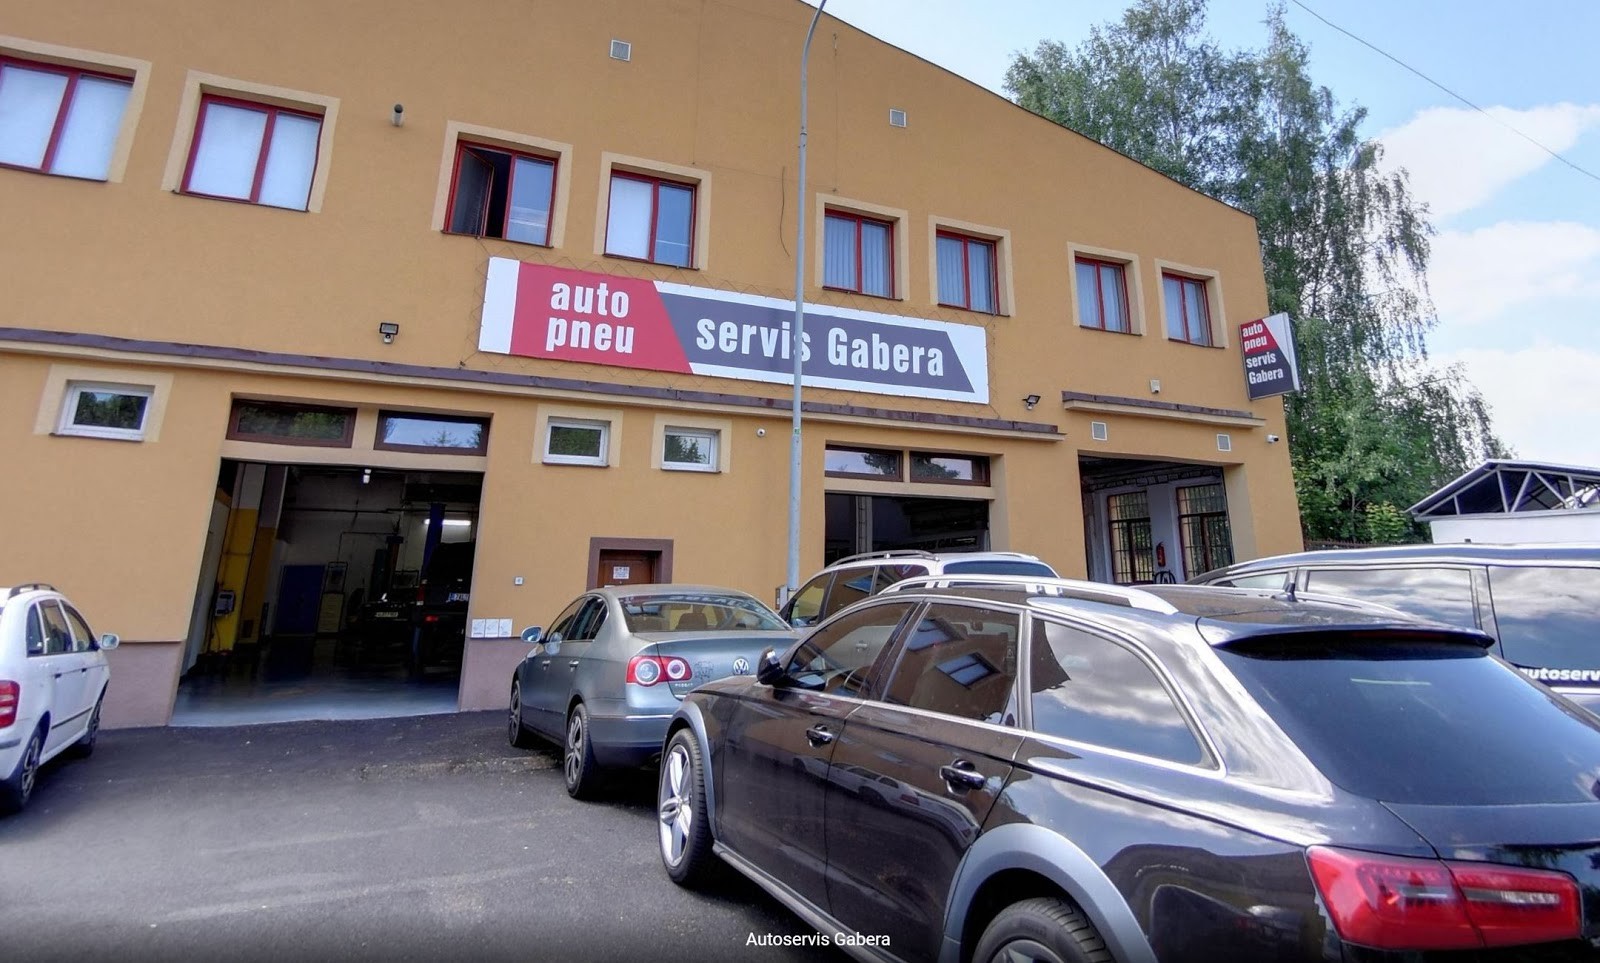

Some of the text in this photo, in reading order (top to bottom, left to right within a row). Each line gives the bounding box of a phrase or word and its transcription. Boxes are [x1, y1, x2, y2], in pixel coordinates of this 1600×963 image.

[550, 282, 629, 318] auto
[545, 317, 635, 354] pneu
[1242, 323, 1263, 337] auto
[696, 318, 945, 377] servis Gabera
[1244, 336, 1268, 352] pneu
[1246, 352, 1276, 368] servis
[1248, 368, 1283, 384] Gabera
